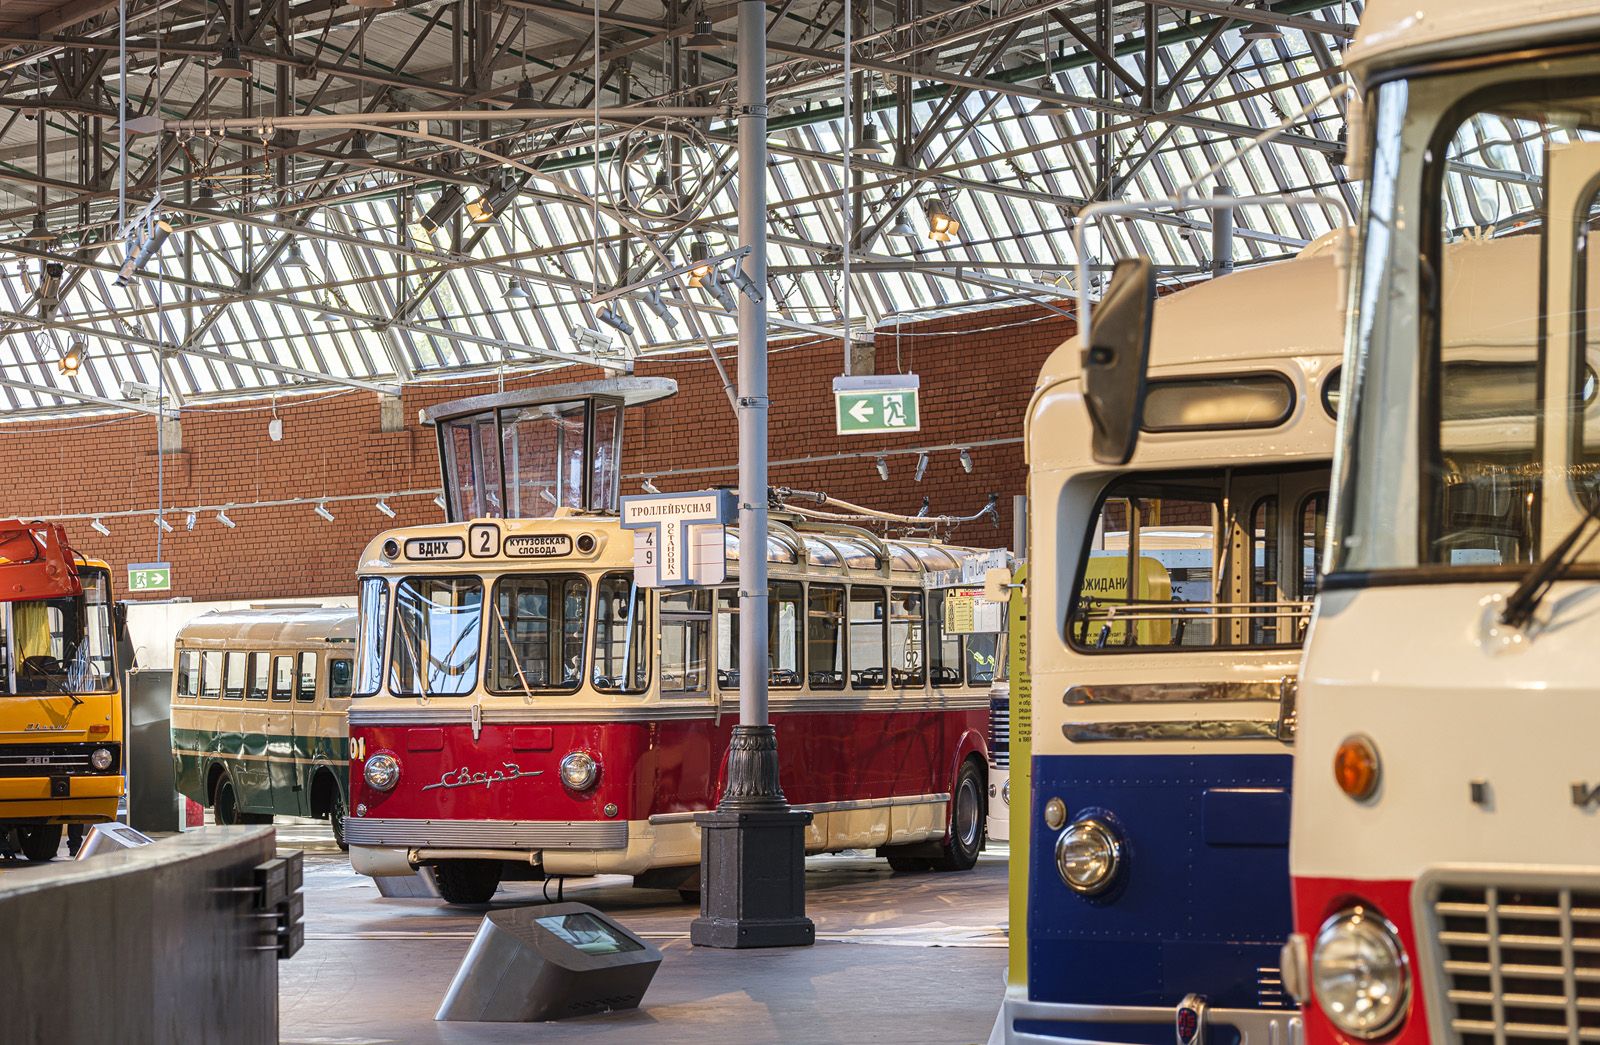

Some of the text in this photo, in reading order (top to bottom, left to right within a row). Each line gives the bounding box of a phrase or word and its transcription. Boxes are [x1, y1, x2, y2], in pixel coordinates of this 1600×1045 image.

[631, 503, 711, 516] ТРОЛЛЕЙБУСНАЯ
[480, 531, 490, 552] 2
[510, 537, 565, 546] КУТУЗОВСКАЯ
[646, 533, 652, 546] 4
[418, 542, 448, 556] ВДНХ
[518, 547, 556, 555] СЛОБОДА
[667, 523, 675, 575] ОСТАНОВКА
[646, 551, 652, 564] 9
[350, 736, 366, 761] 01
